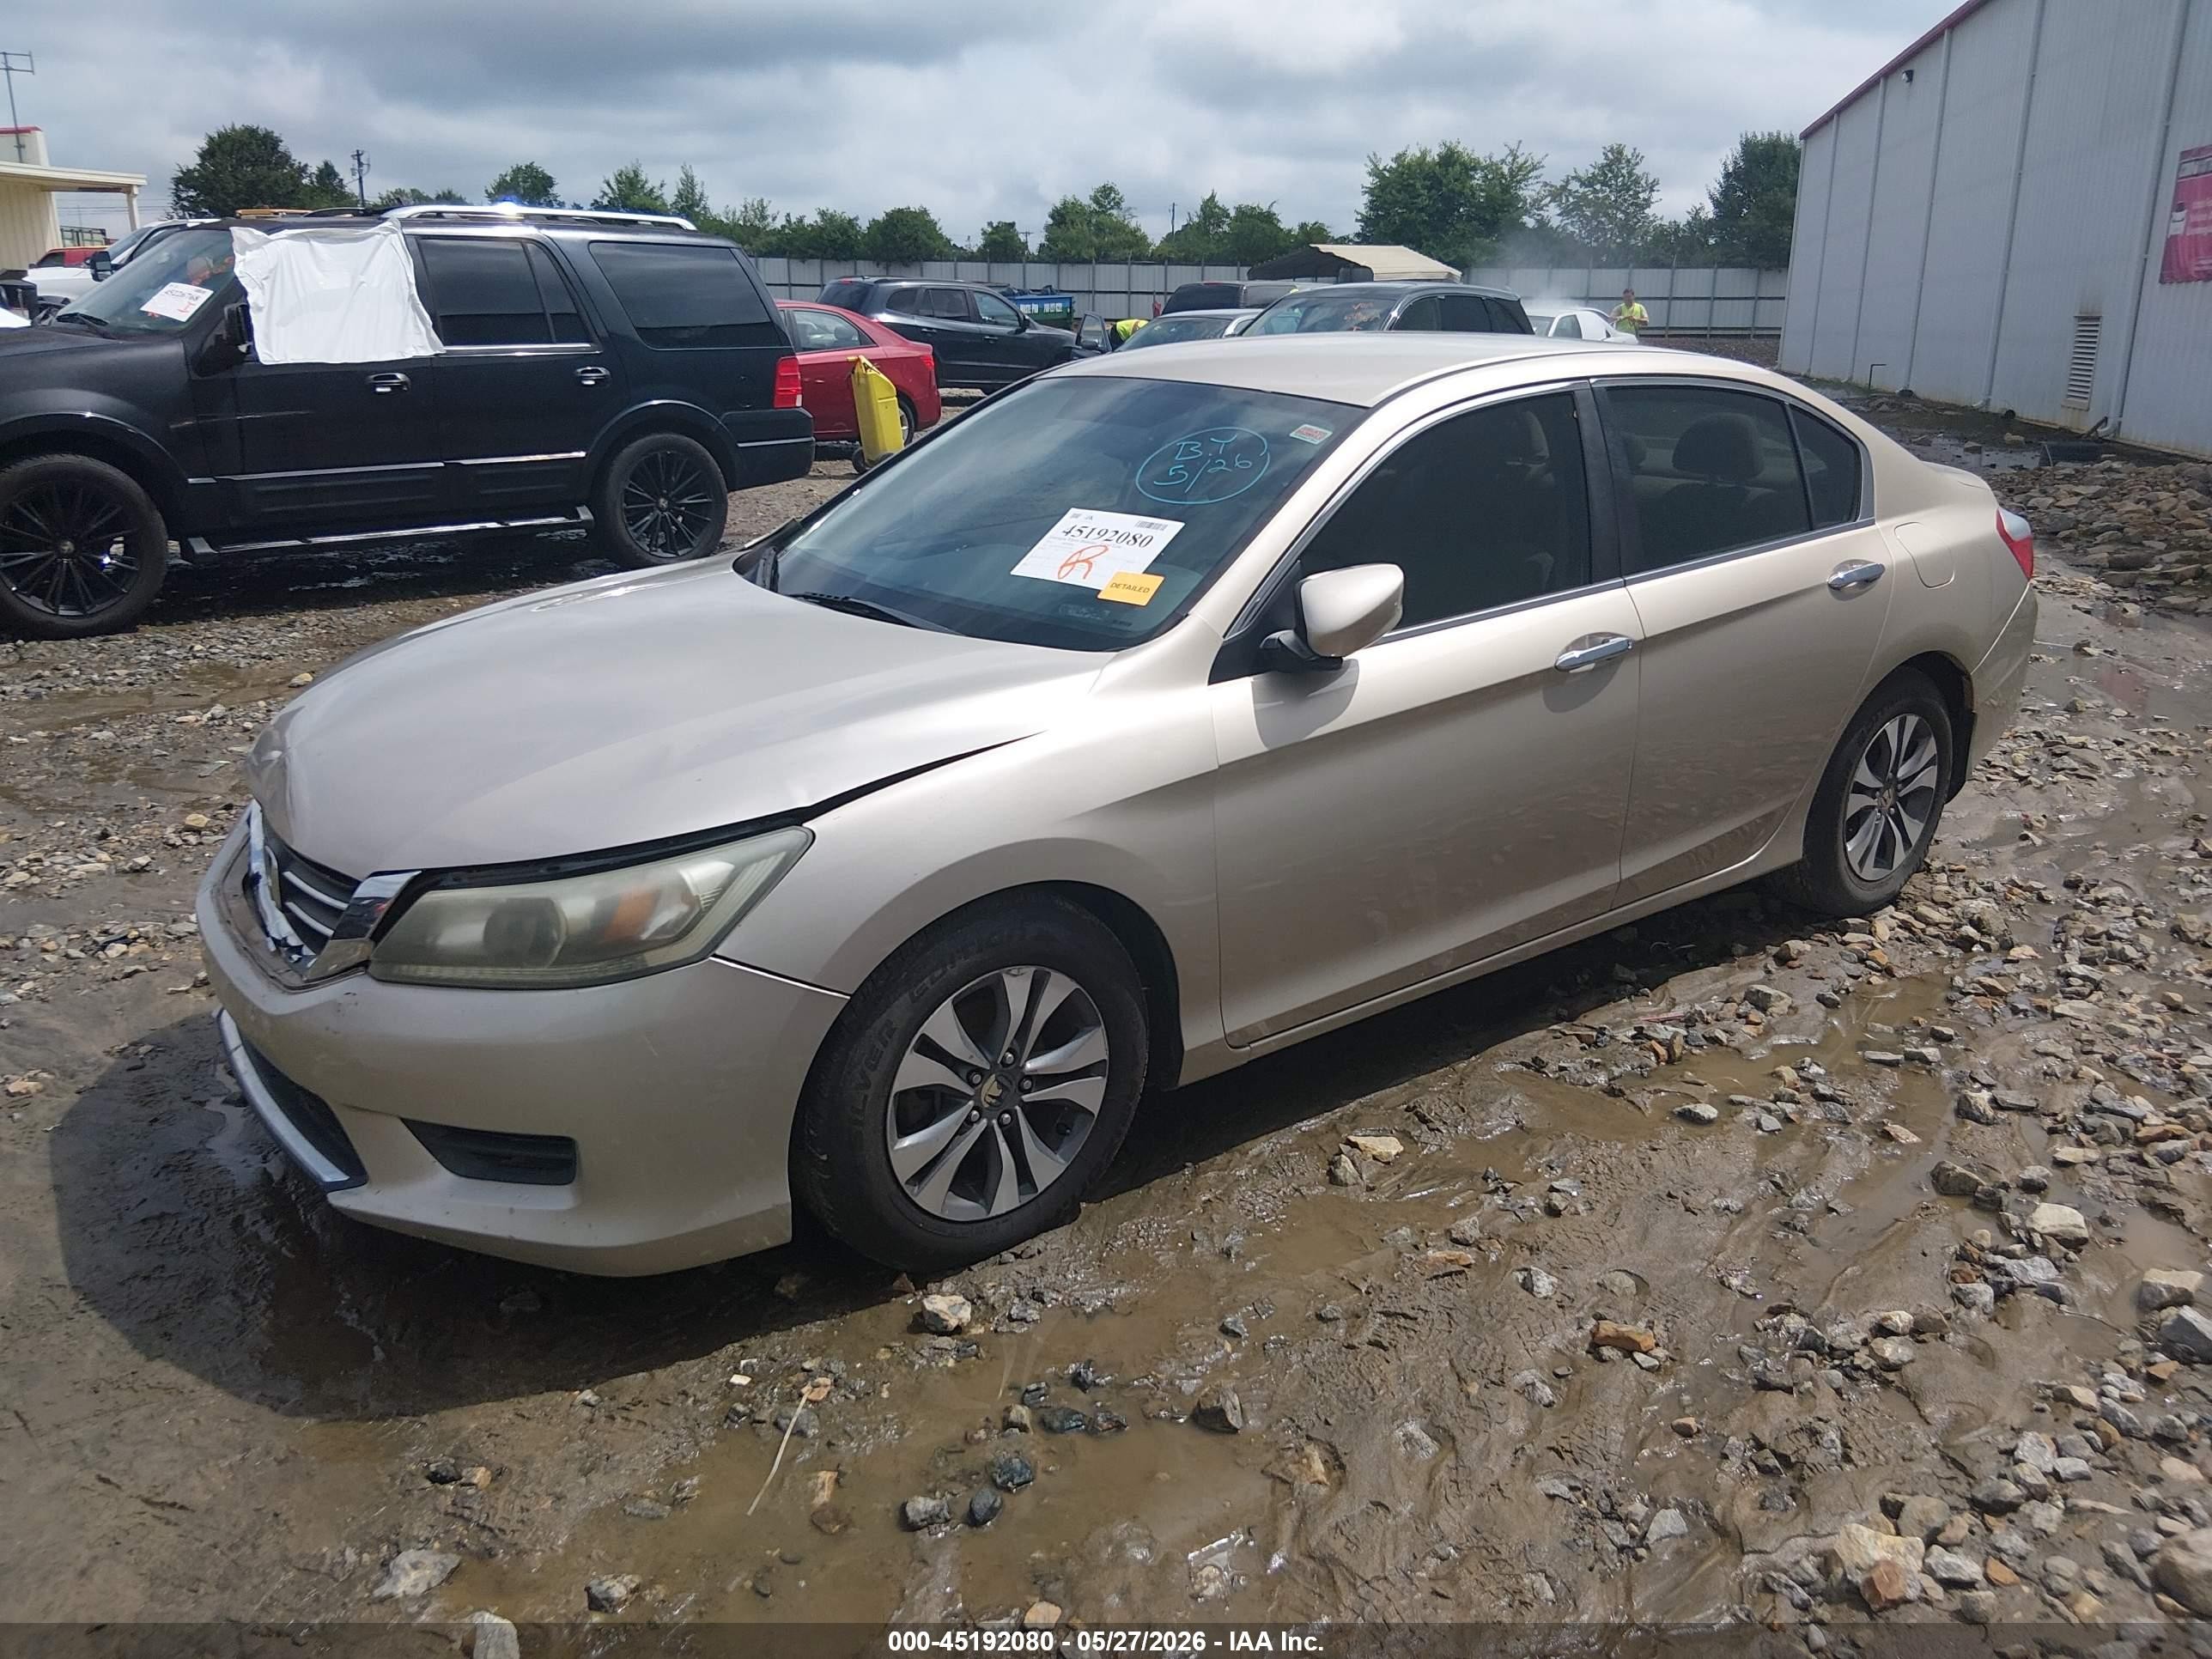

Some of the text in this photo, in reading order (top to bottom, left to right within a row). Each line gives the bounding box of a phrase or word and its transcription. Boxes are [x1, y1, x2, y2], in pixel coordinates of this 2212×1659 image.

[1153, 453, 1253, 494] 5/26
[1061, 523, 1154, 549] 45192080
[1109, 580, 1151, 593] DETAILED
